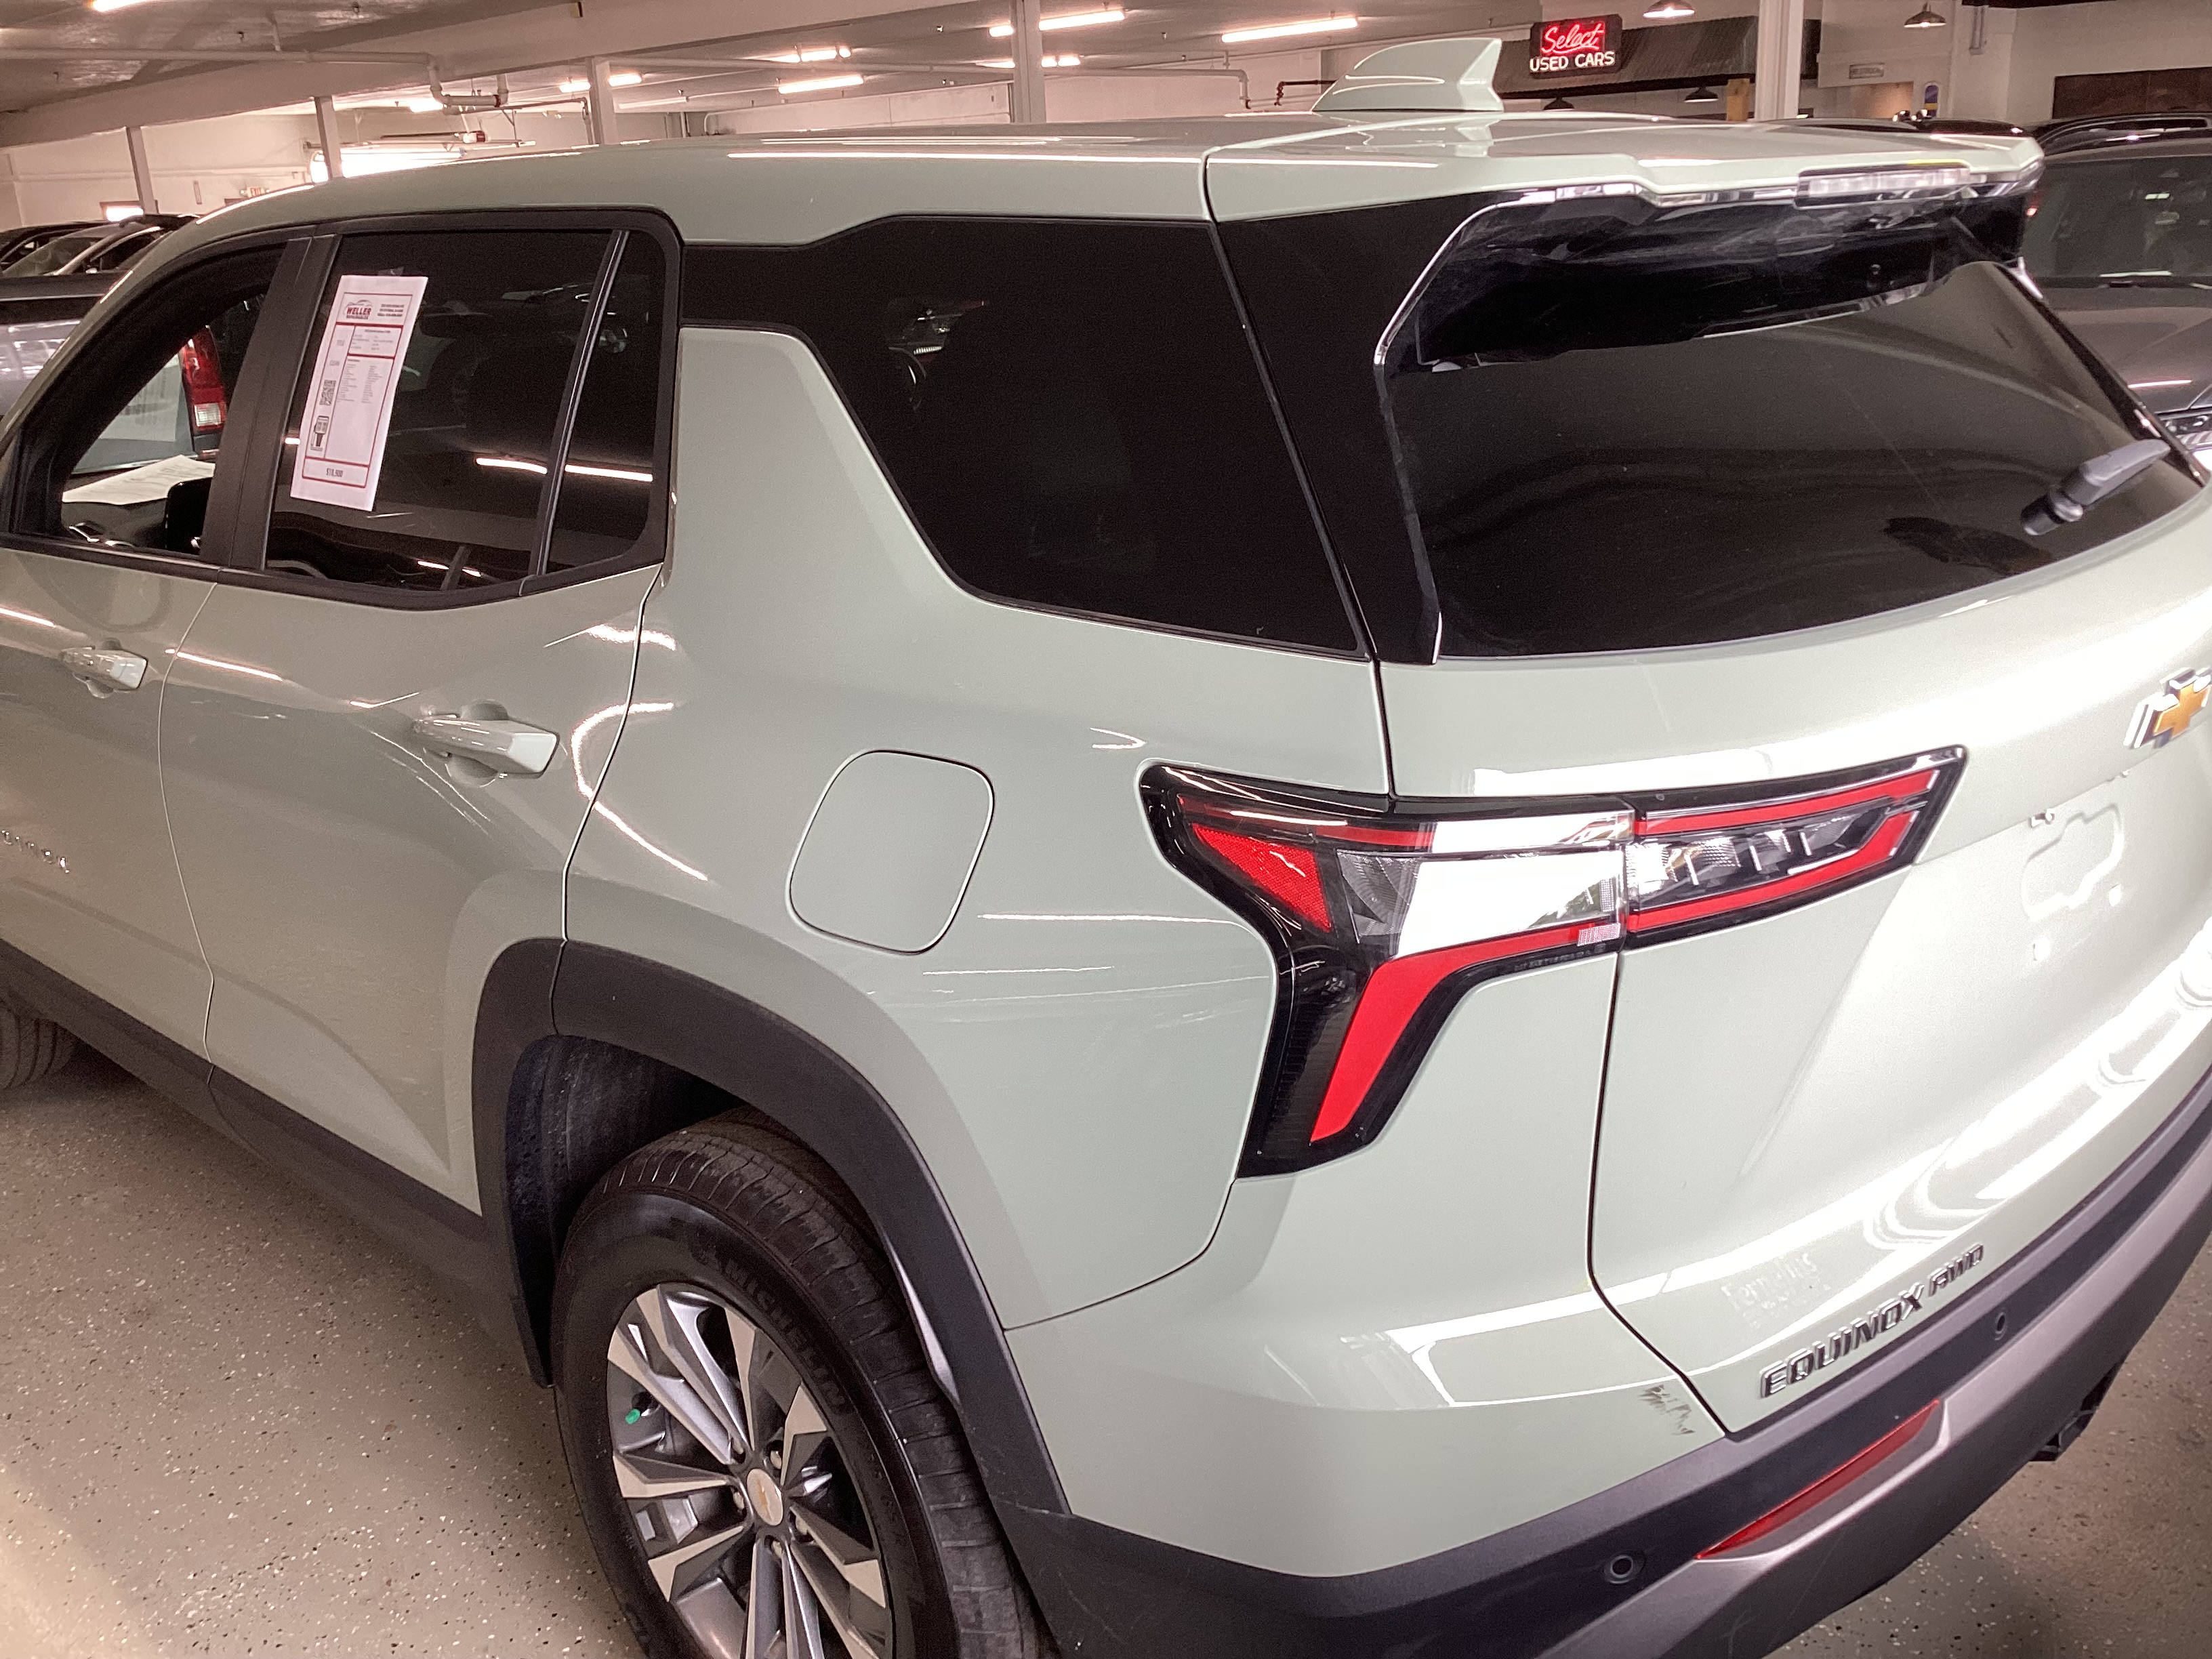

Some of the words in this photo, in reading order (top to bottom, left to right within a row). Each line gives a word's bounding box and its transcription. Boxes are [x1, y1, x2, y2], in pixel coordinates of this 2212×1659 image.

[1540, 22, 1605, 54] Select
[1530, 56, 1569, 72] USED
[1574, 51, 1616, 68] CARS
[346, 306, 371, 316] WELLER
[1760, 1282, 1925, 1398] EQUINOX
[1929, 1243, 1984, 1296] AWD
